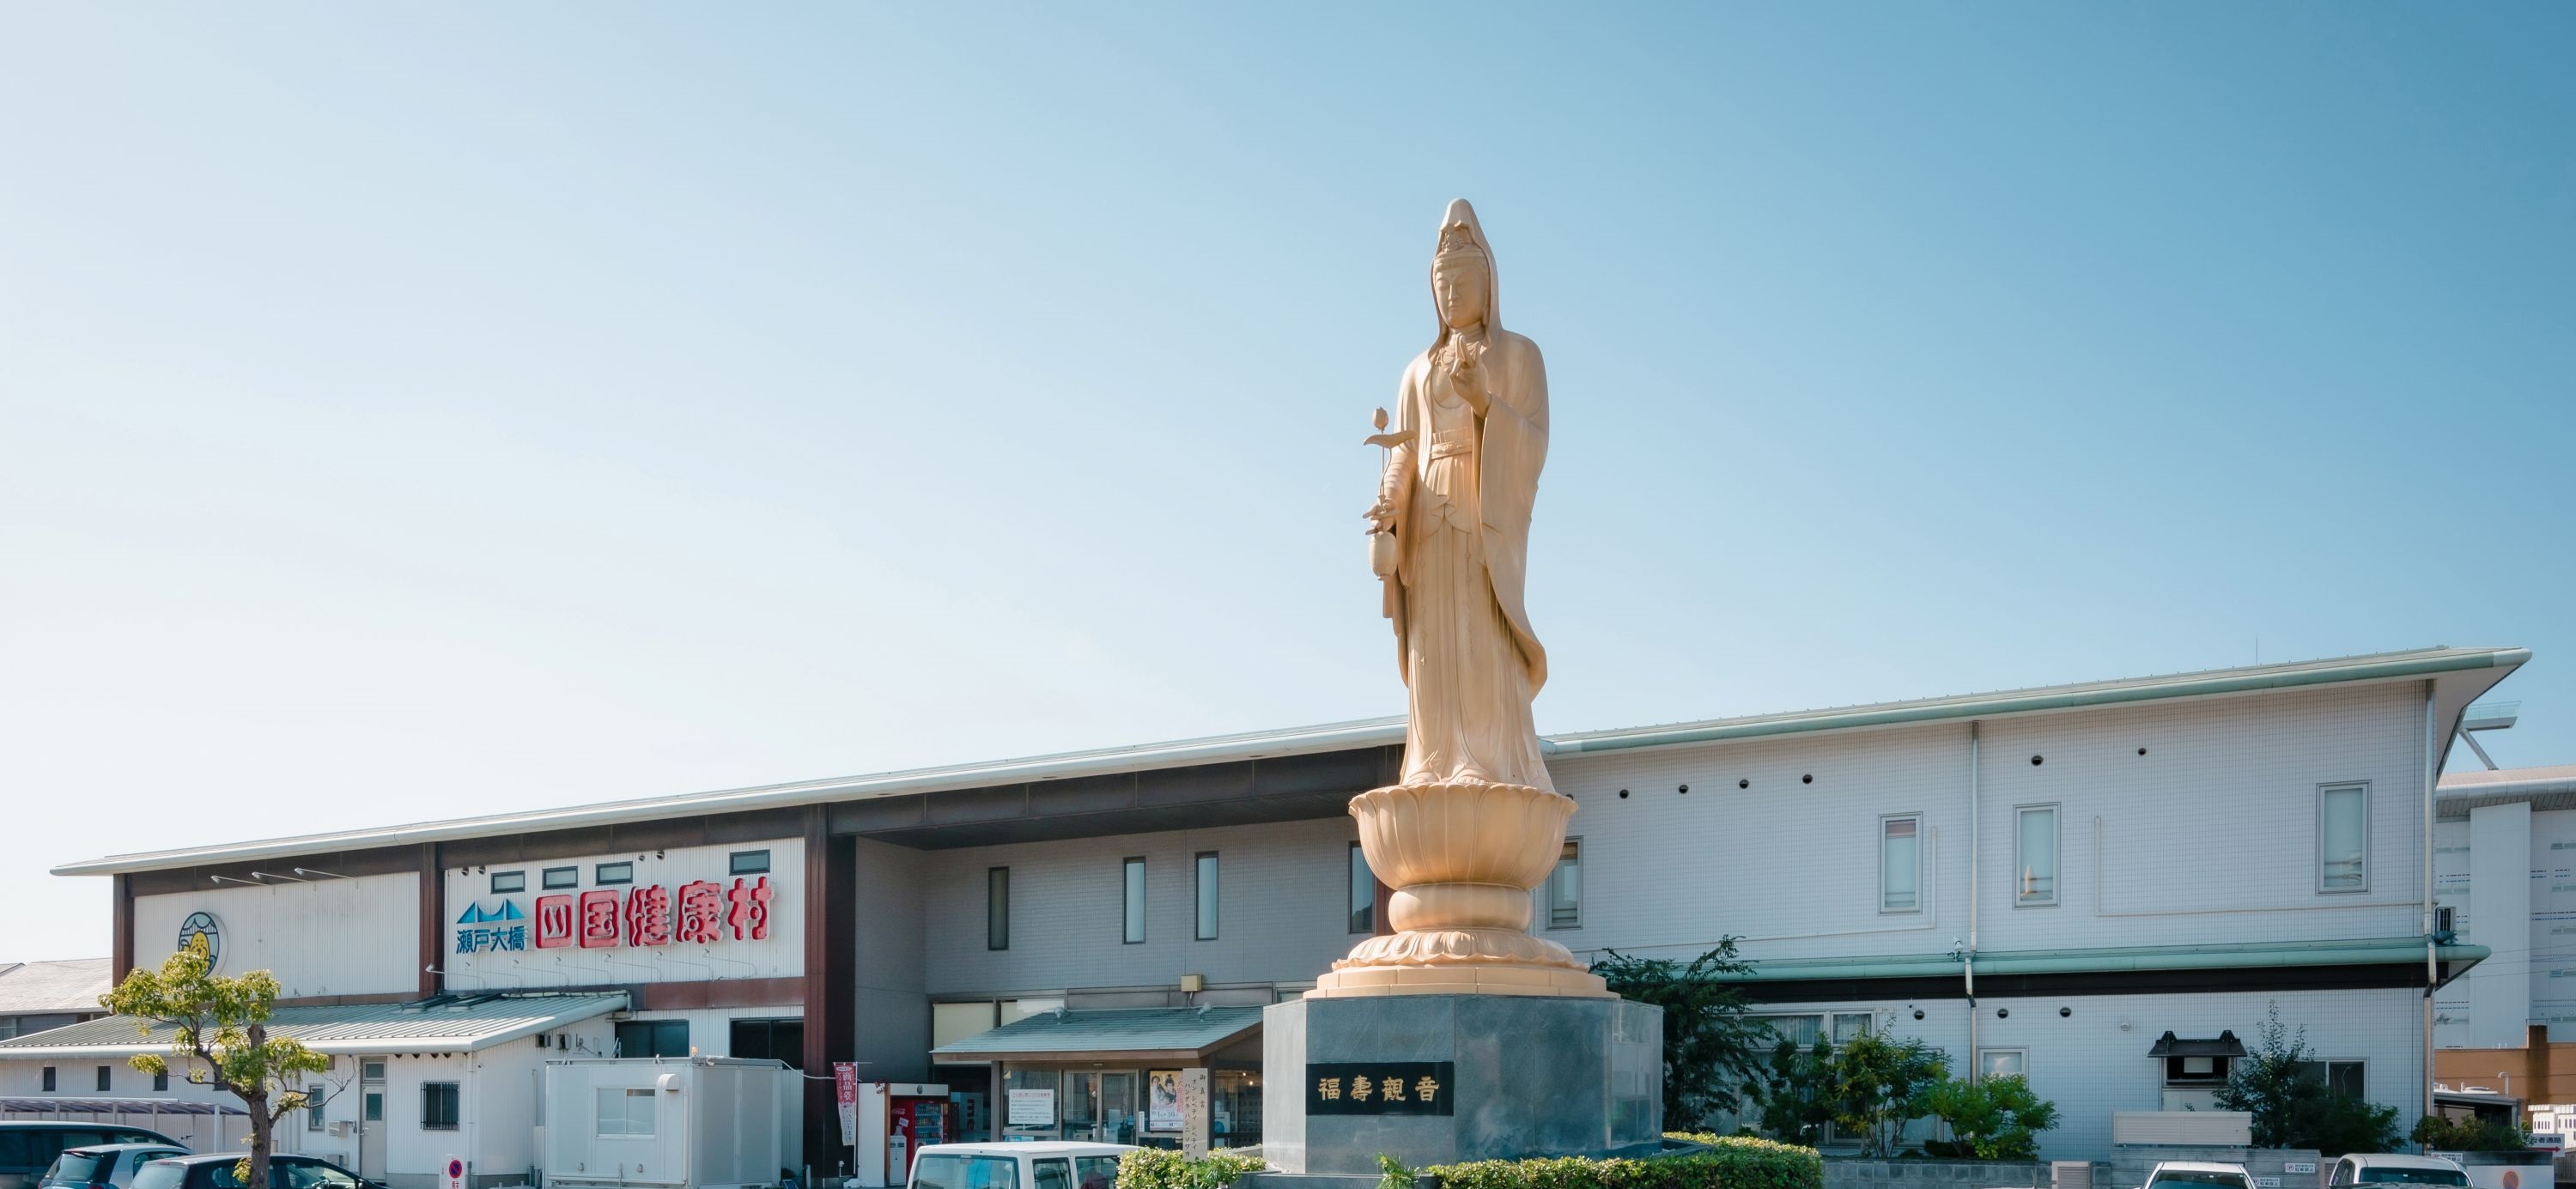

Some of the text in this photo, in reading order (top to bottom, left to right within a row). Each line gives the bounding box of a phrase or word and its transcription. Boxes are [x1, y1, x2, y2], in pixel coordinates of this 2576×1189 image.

[535, 877, 773, 949] 四国健康村
[456, 925, 525, 955] 瀬戸大橋
[1318, 1074, 1440, 1102] 福壽觀音
